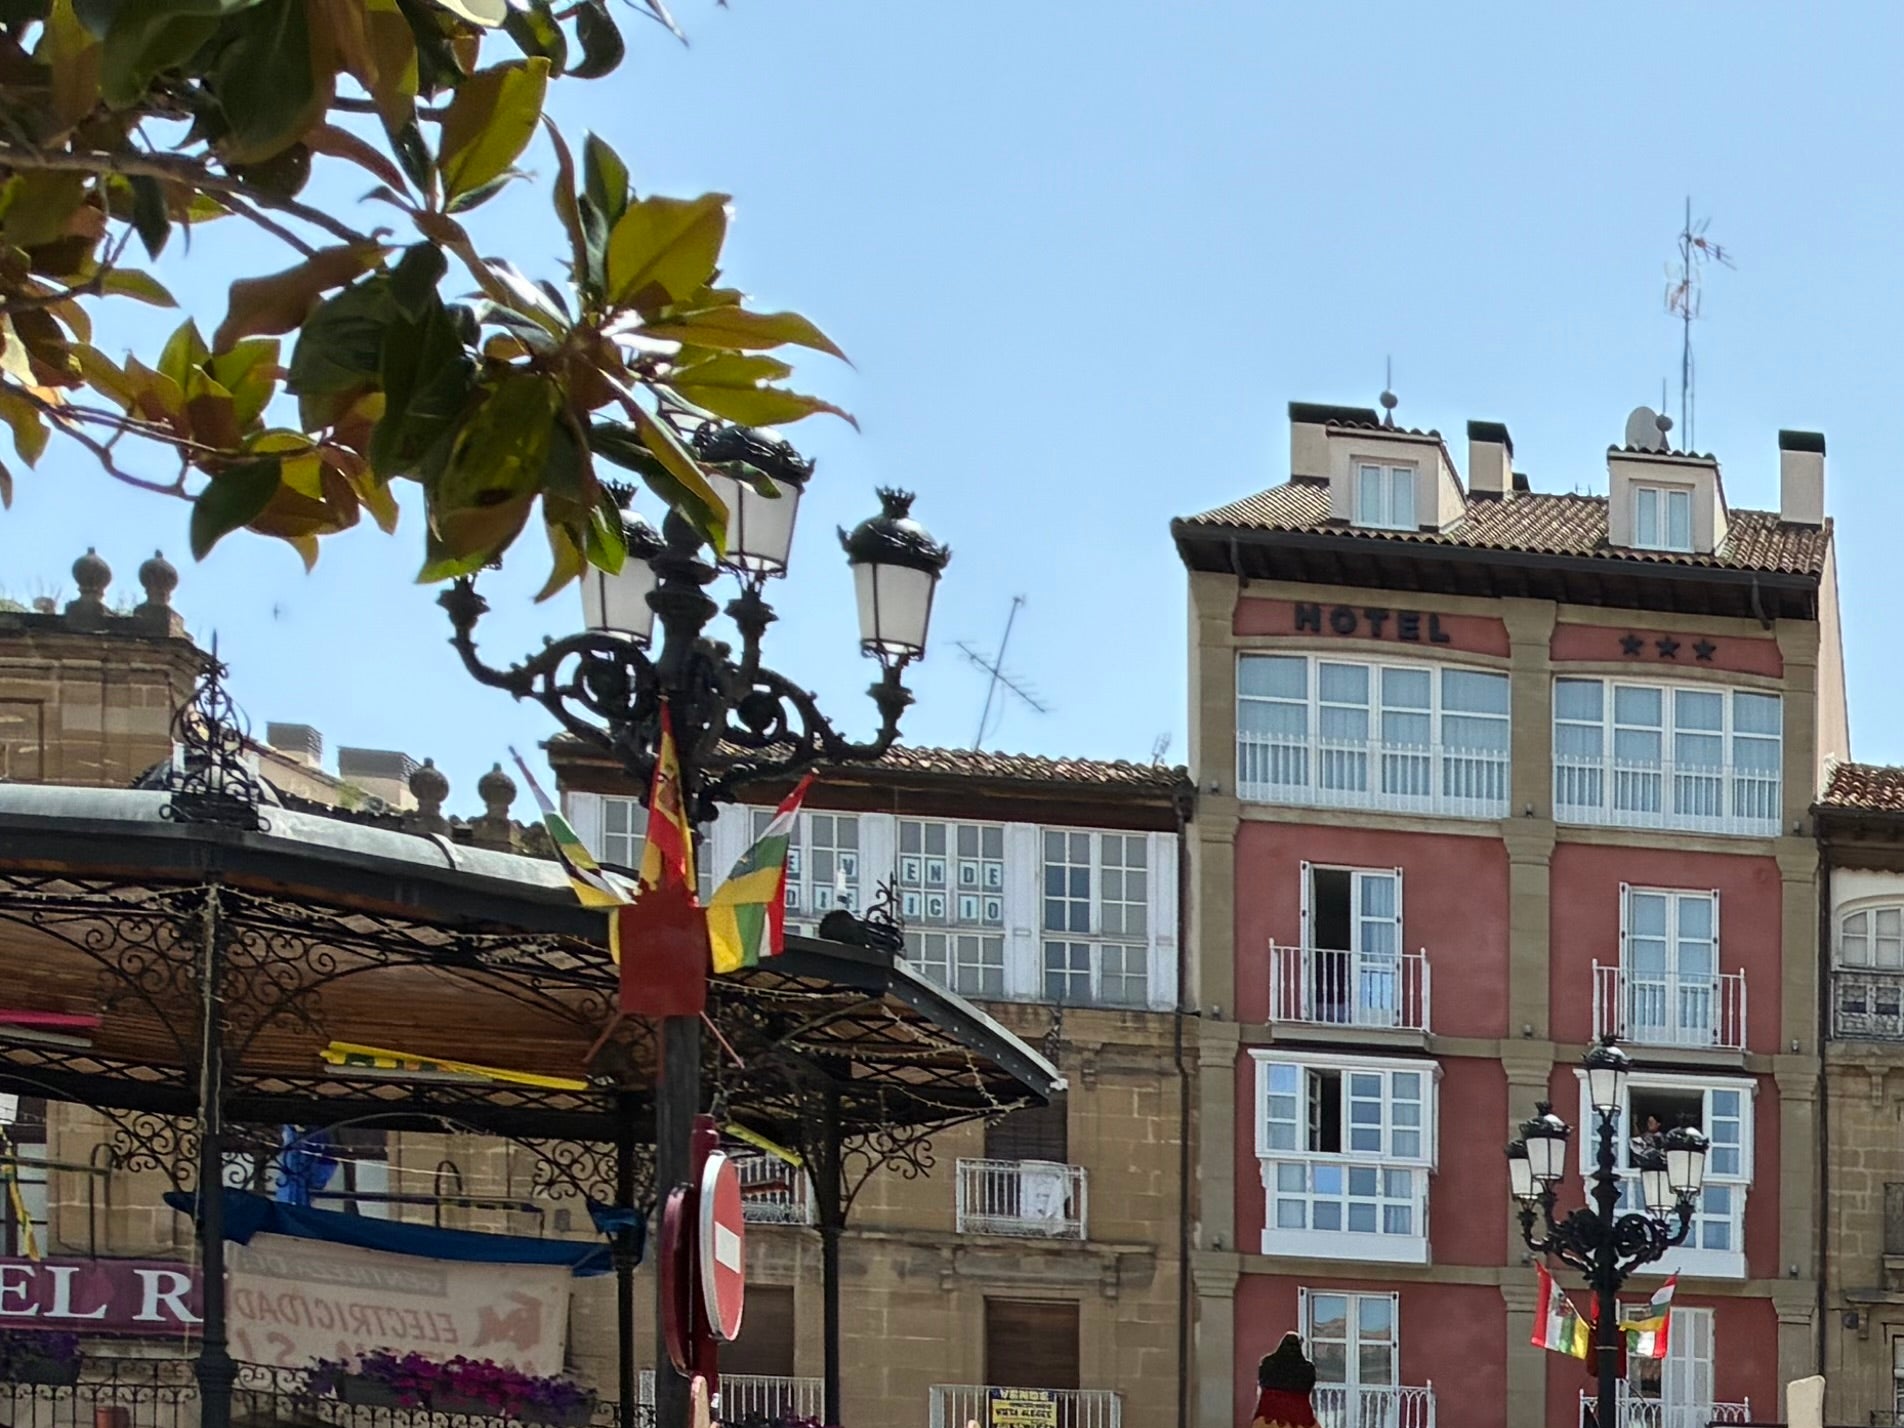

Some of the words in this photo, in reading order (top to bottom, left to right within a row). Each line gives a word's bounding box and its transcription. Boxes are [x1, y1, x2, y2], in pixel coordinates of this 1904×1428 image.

[1294, 602, 1450, 643] HOTEL
[842, 858, 998, 885] VENDE
[1000, 1388, 1049, 1401] VENDE
